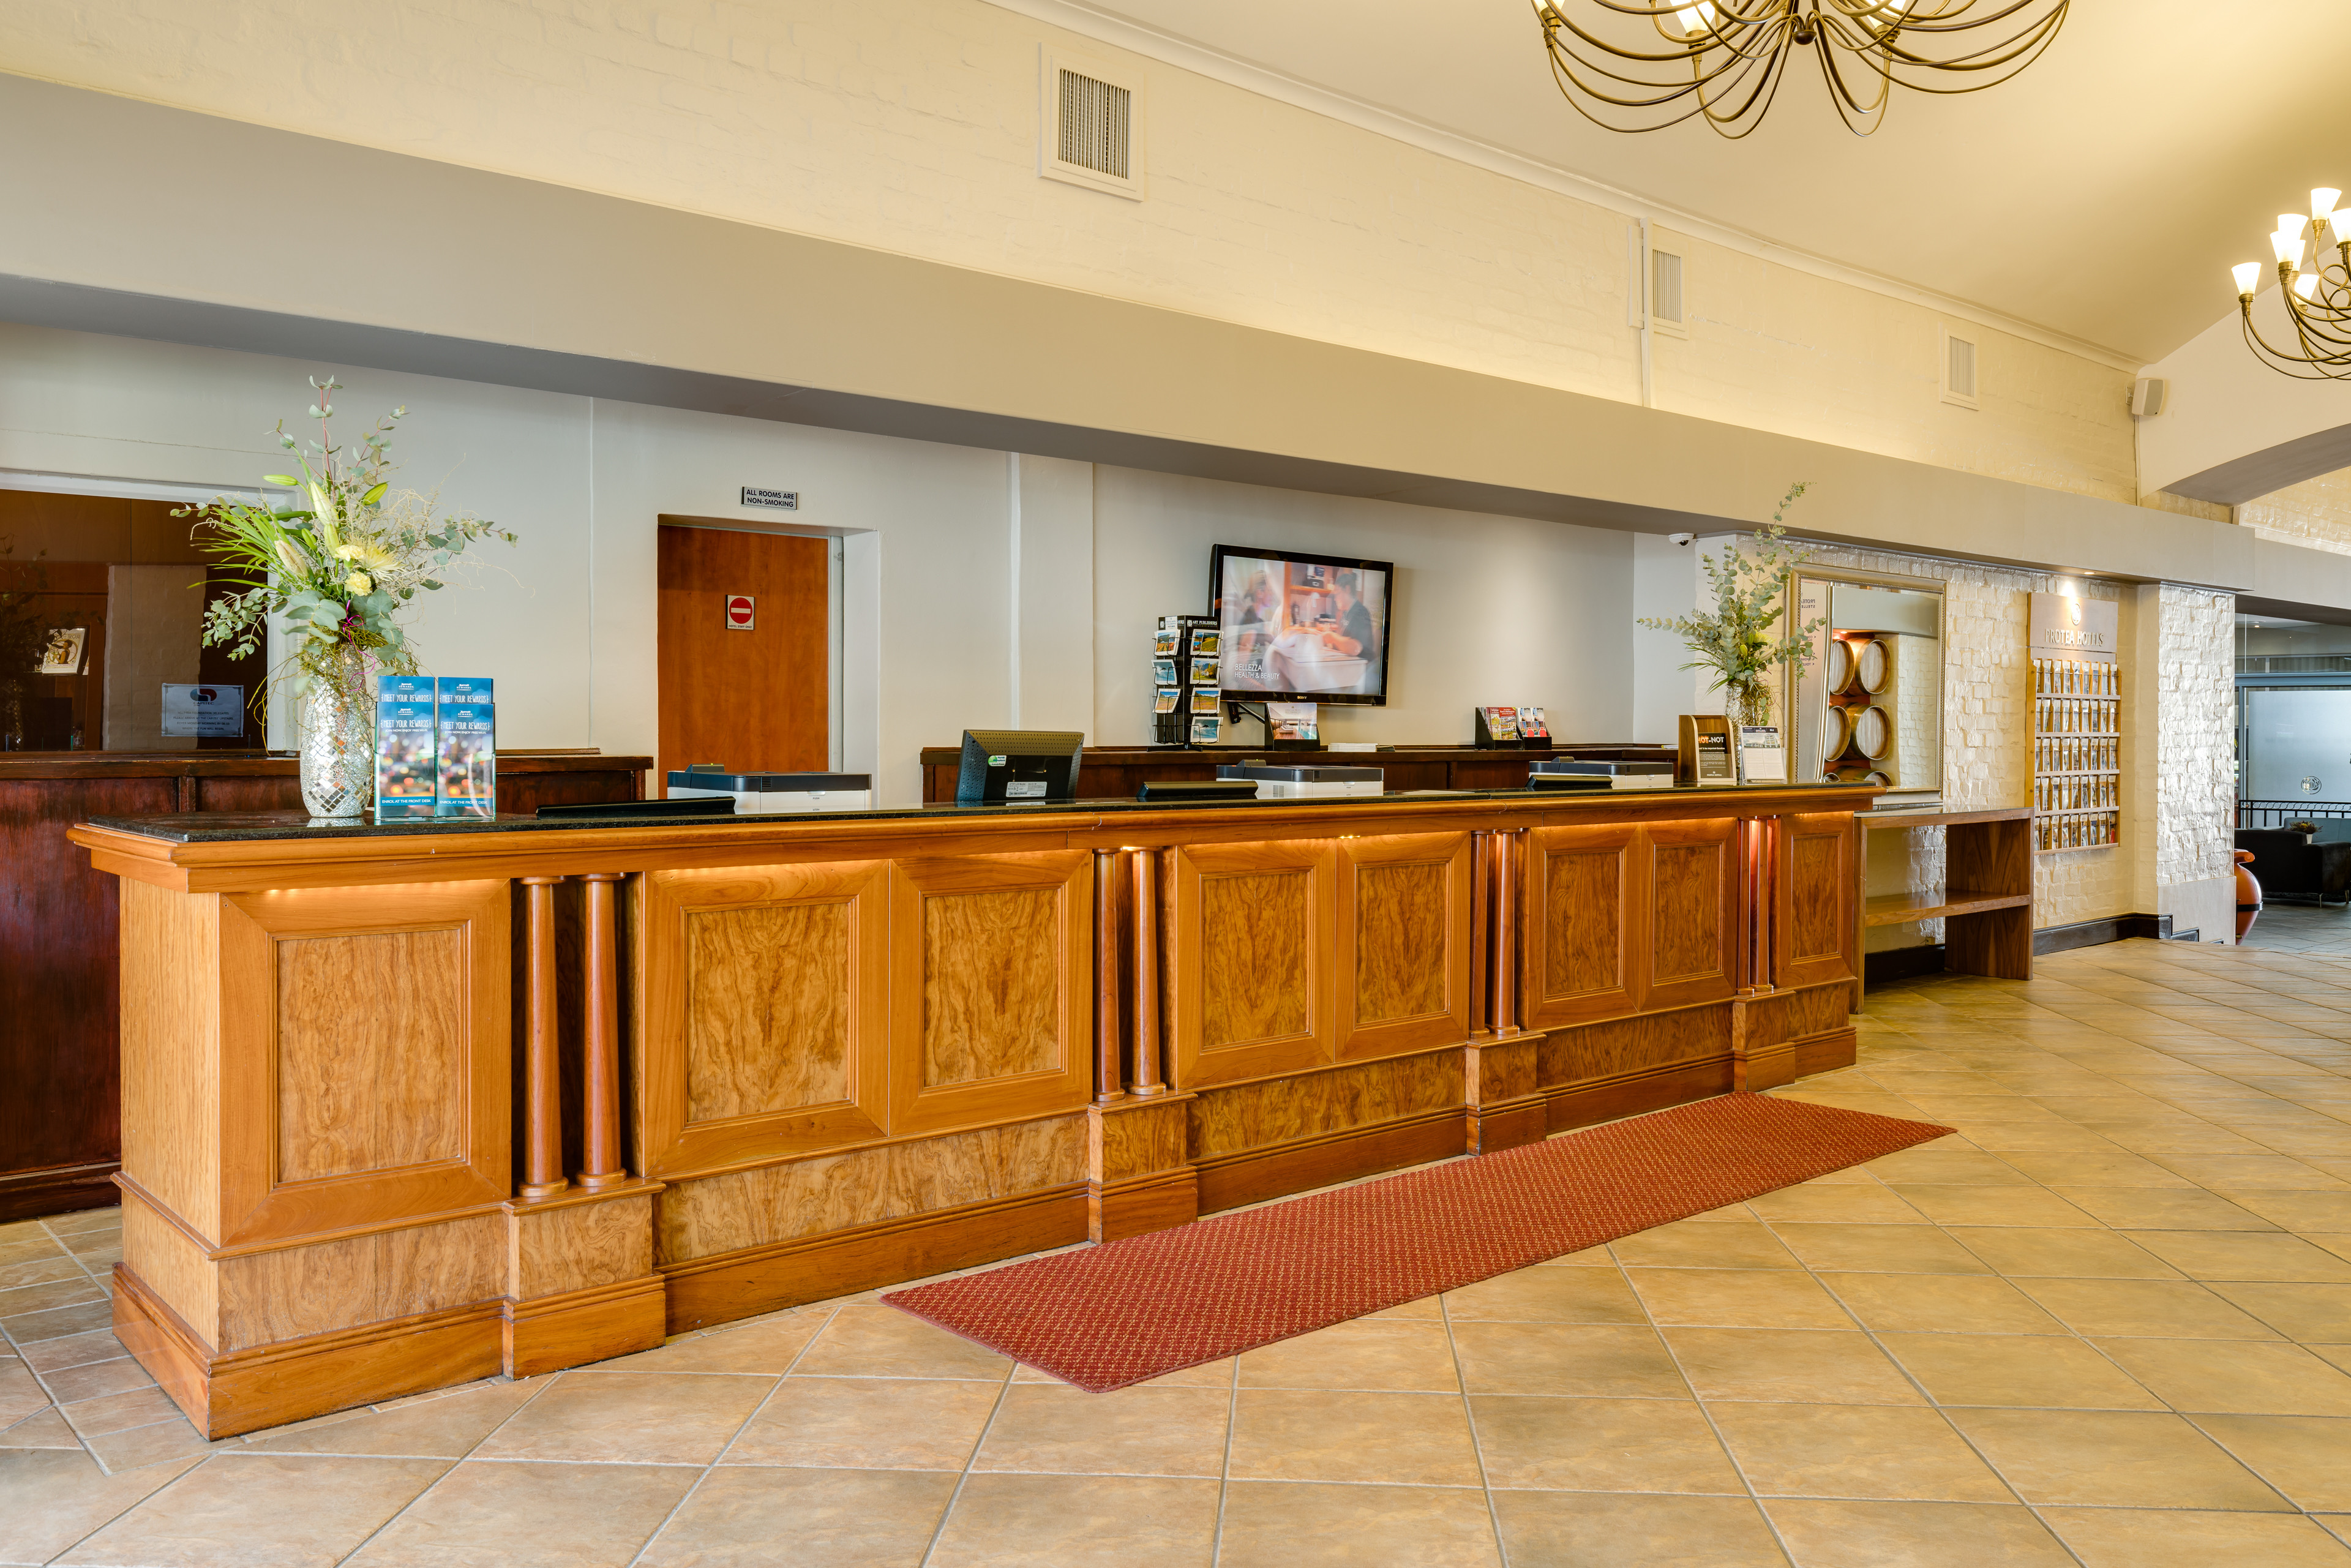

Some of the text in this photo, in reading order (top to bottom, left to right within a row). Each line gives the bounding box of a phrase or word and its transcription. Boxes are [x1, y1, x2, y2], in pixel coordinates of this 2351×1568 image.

[747, 497, 793, 508] NON-SMOKING
[2045, 629, 2104, 647] PROTEA HOTELS
[1235, 663, 1262, 672] BELLEZZA
